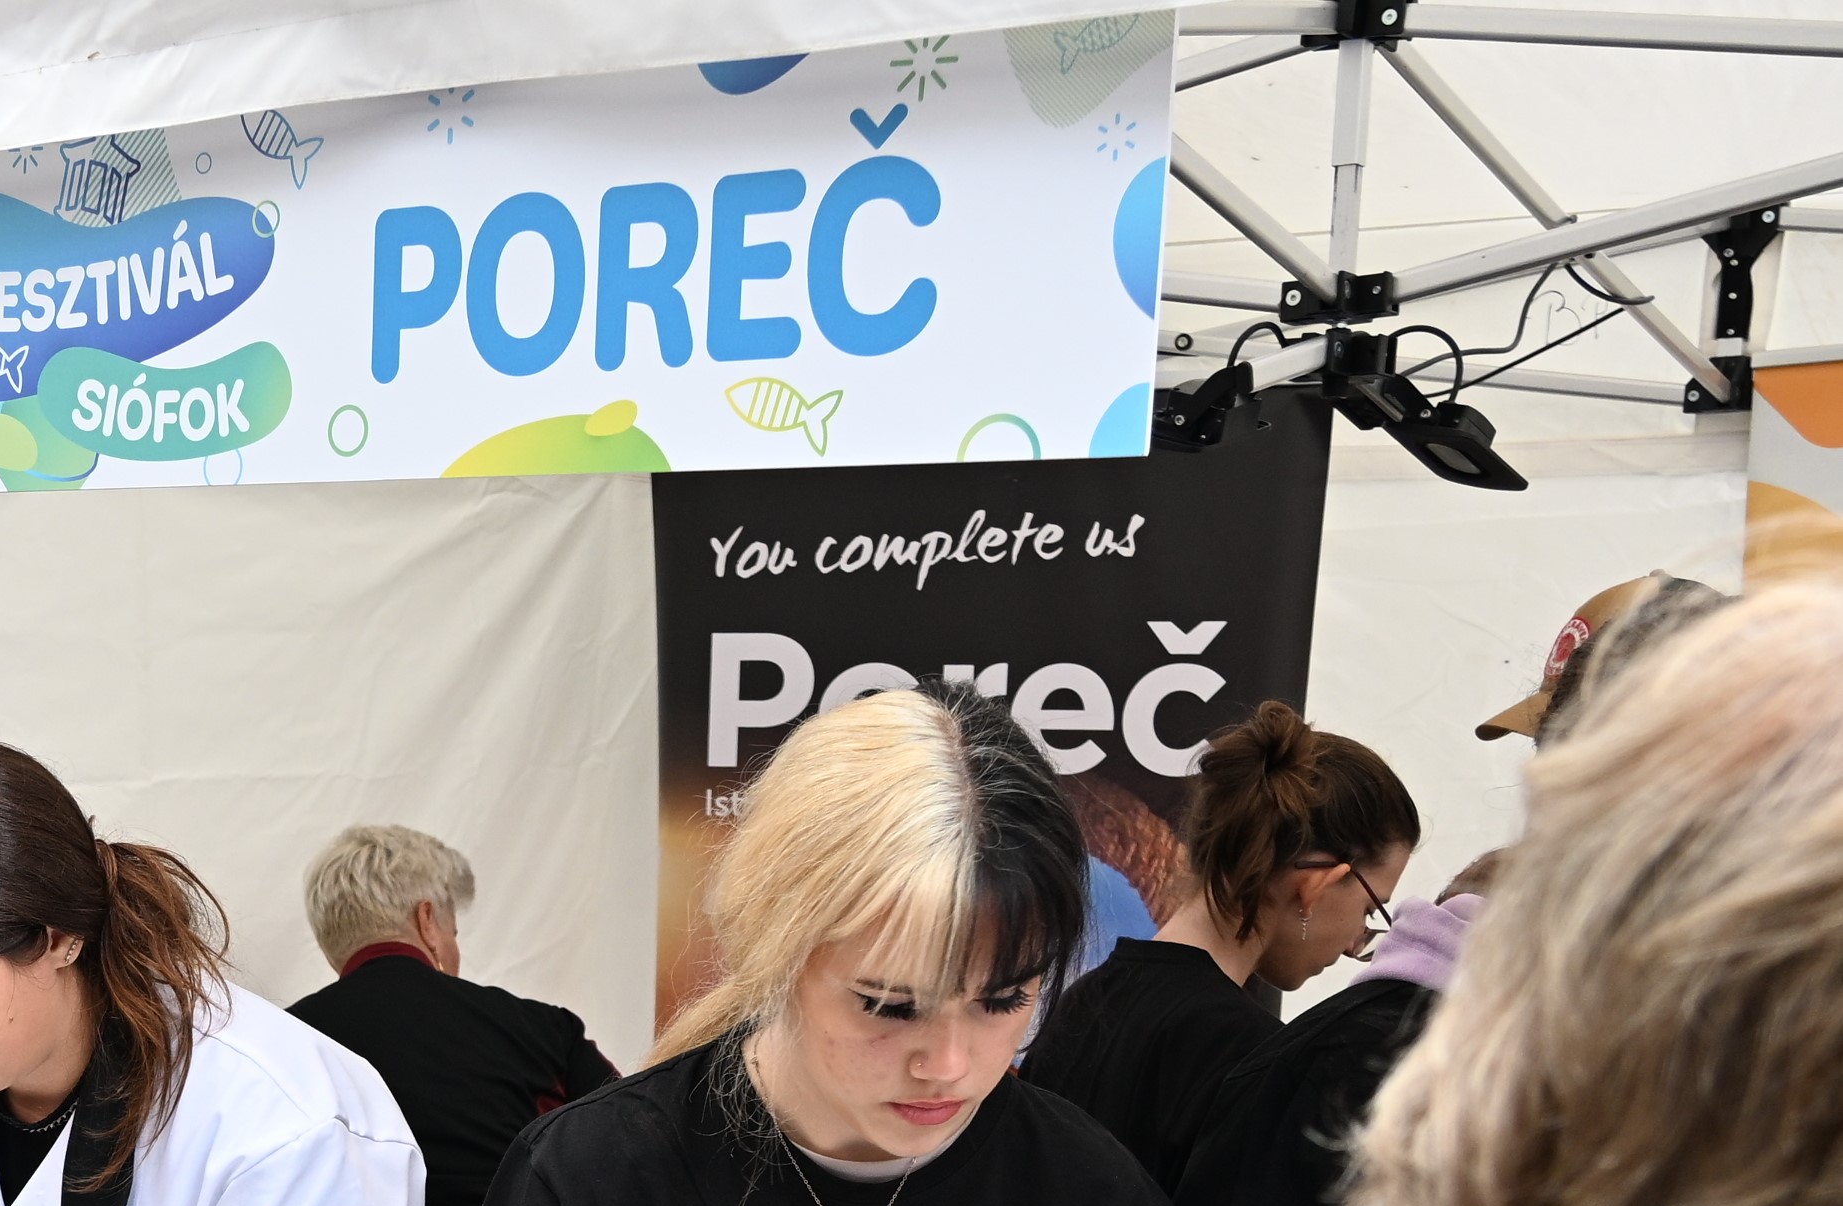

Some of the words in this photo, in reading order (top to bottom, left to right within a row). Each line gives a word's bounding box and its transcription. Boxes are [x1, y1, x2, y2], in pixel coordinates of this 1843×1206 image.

[372, 103, 942, 384] POREČ
[71, 373, 250, 441] SIÓFOK
[710, 526, 797, 578] You
[814, 509, 1064, 591] complete
[1084, 514, 1145, 558] us
